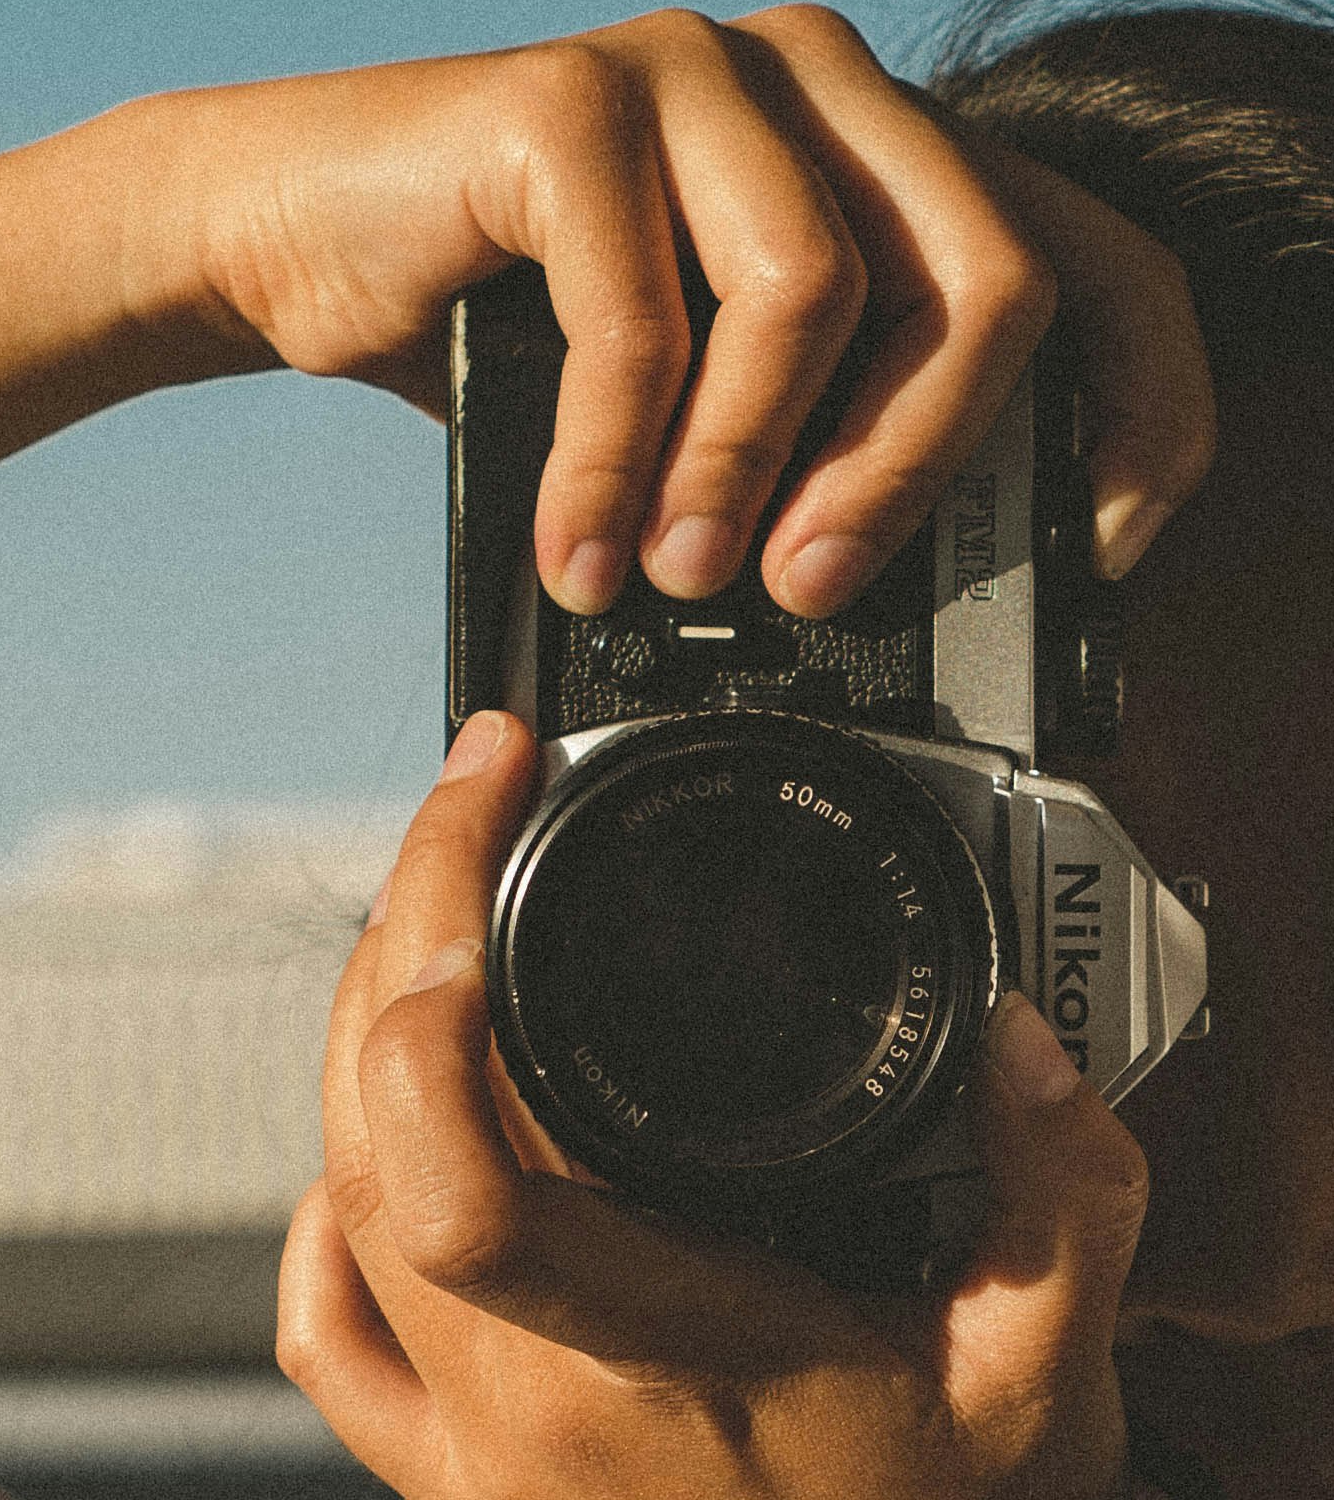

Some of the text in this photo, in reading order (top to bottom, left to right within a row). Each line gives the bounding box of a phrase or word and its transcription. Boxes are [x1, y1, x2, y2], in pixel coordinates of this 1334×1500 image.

[954, 473, 996, 600] FM2
[620, 772, 734, 831] NIKKOR
[779, 780, 854, 831] 50mm
[865, 965, 932, 1097] 5618548
[572, 1046, 649, 1129] Nikon
